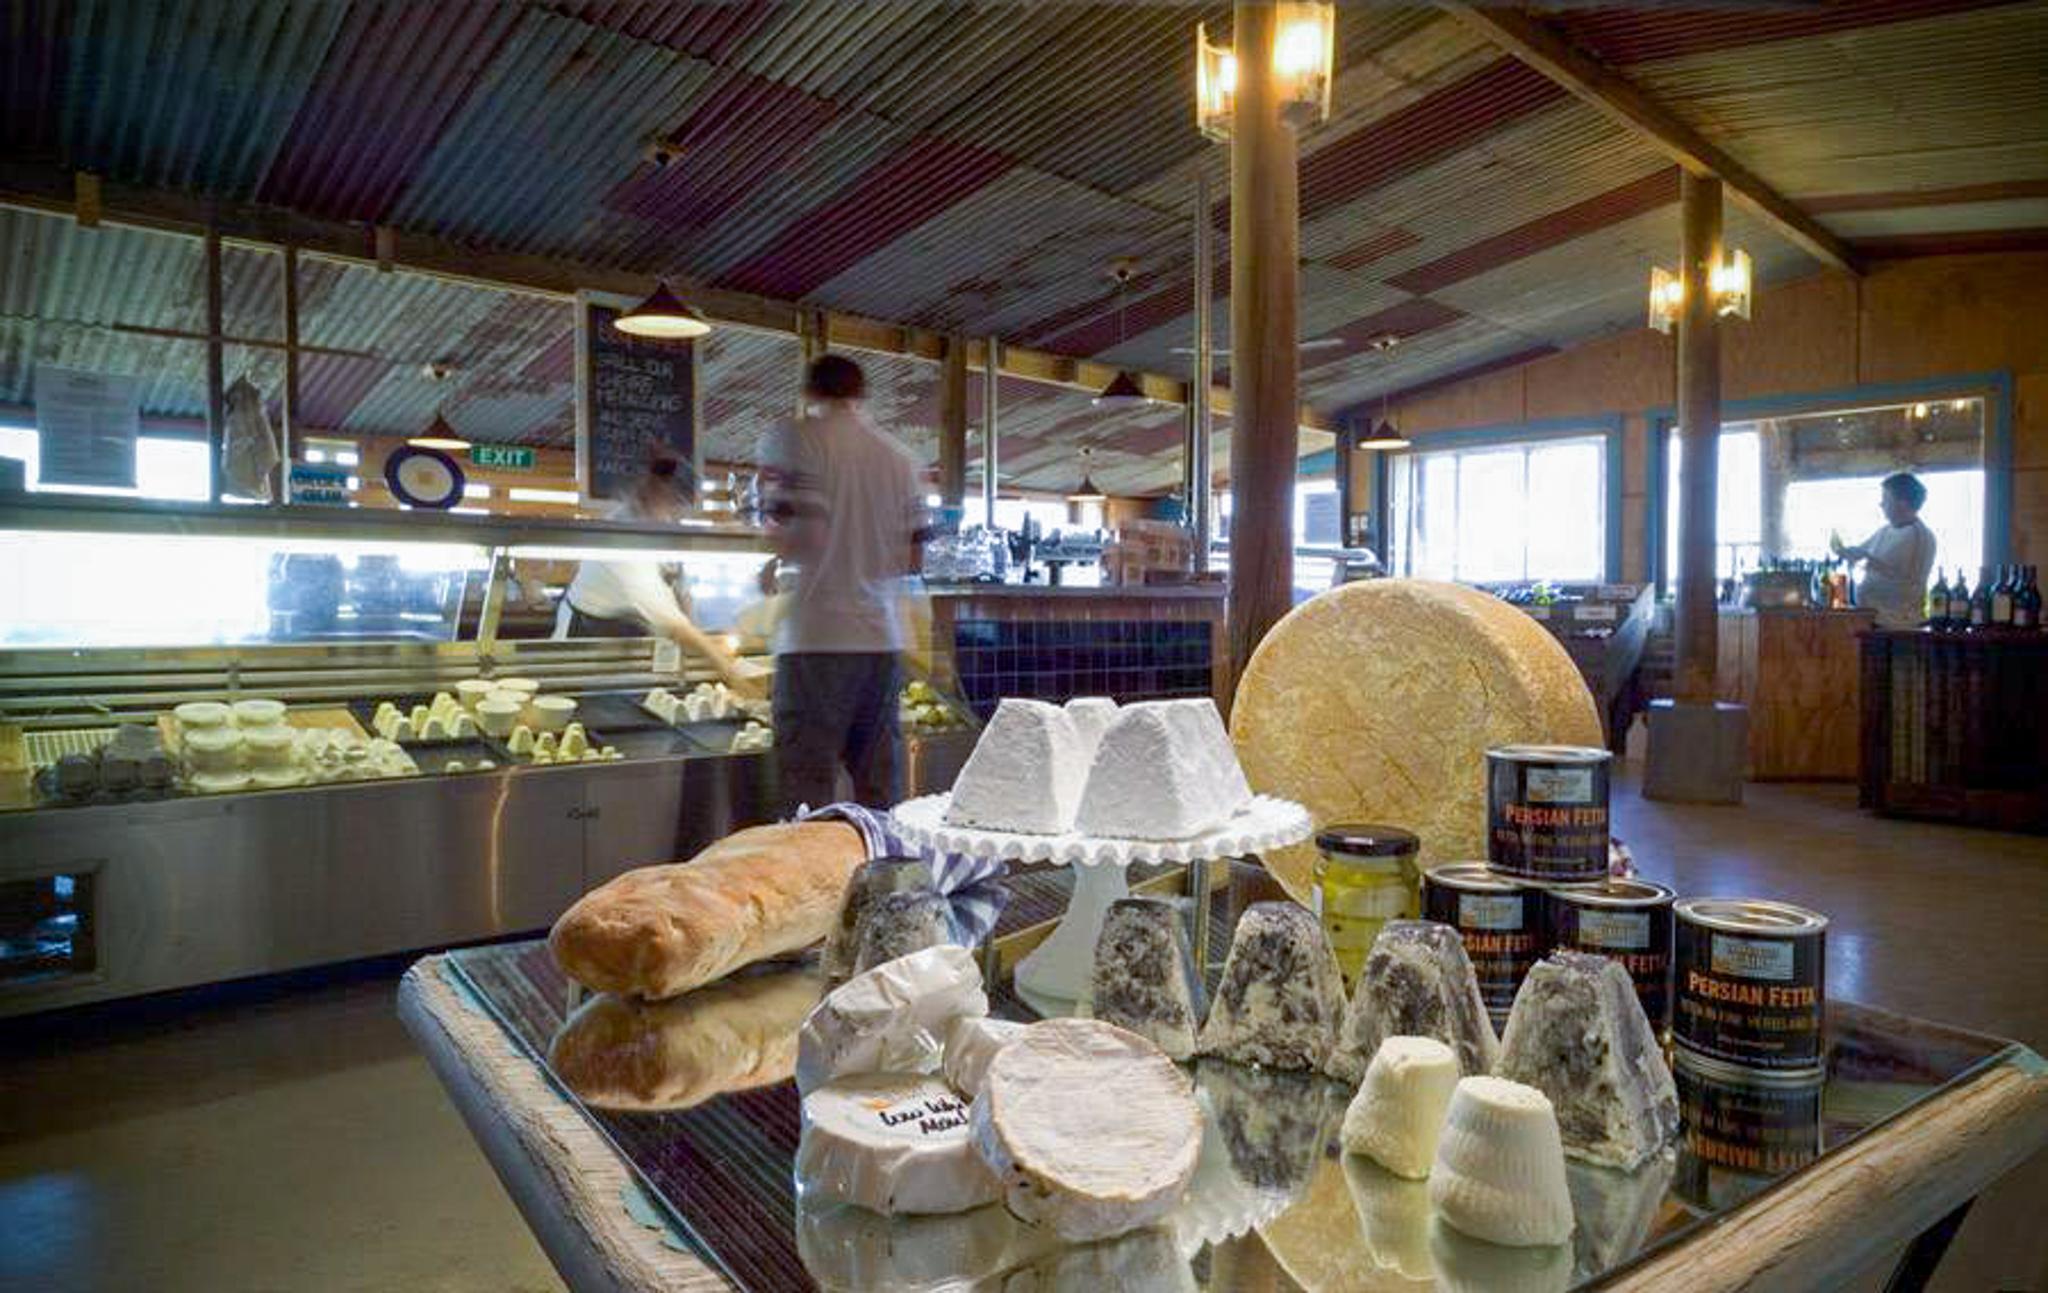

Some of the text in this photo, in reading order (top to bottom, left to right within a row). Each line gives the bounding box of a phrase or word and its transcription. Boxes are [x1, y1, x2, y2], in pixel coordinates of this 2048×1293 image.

[478, 451, 525, 465] EXIT
[1506, 803, 1606, 826] PERSIAN FETT
[1689, 970, 1763, 1005] PERSIAN
